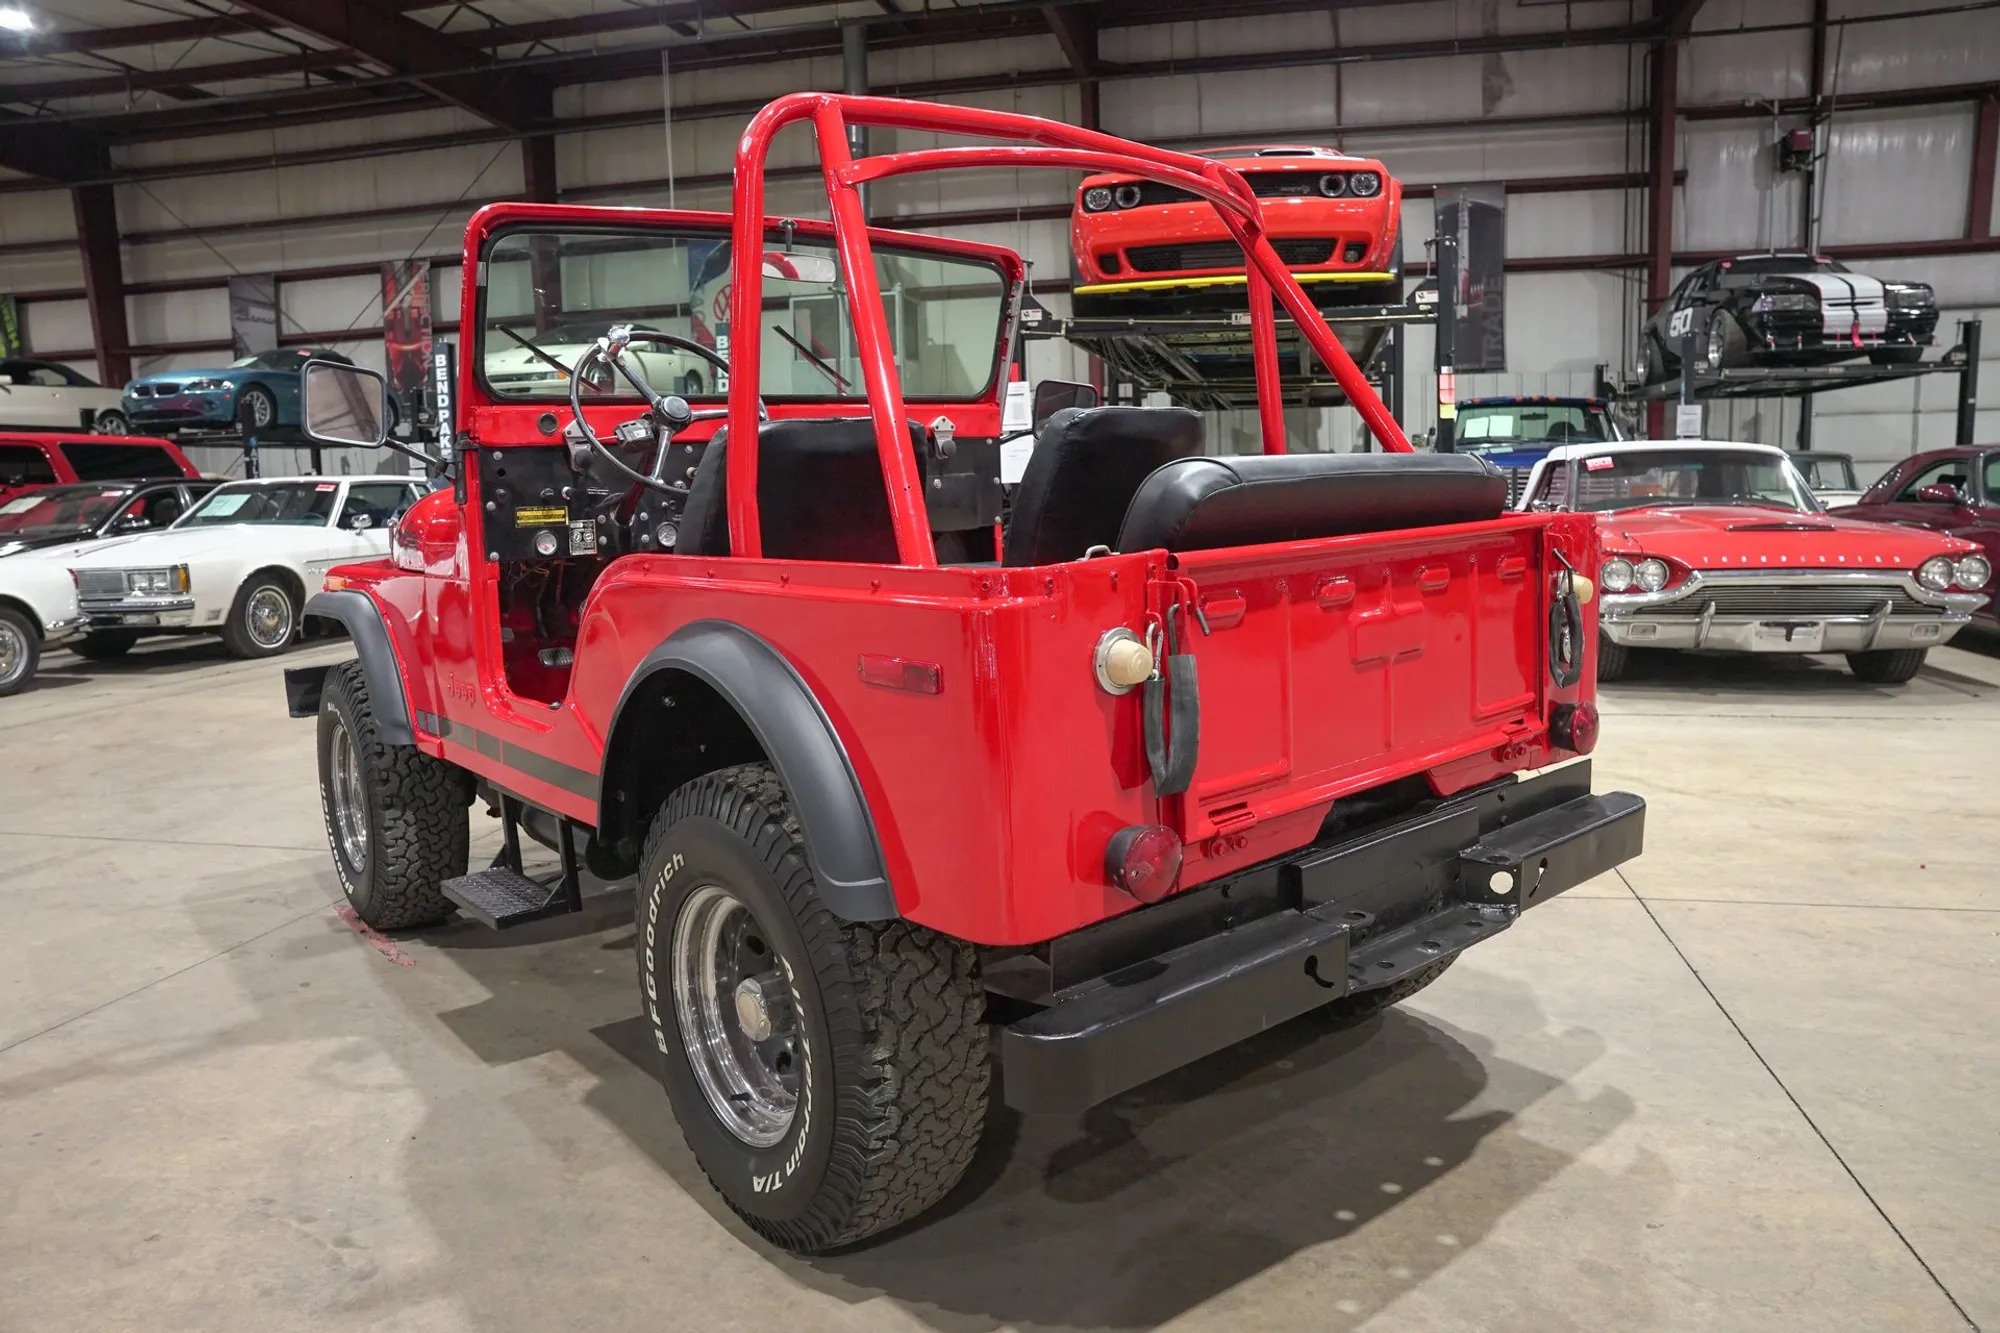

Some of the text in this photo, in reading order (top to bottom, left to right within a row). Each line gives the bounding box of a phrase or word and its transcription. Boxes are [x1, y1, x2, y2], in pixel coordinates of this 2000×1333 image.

[435, 354, 452, 449] BENDPAK
[447, 670, 476, 707] Jeep
[646, 853, 685, 1055] BFGoodrich
[752, 1171, 783, 1193] T/A
